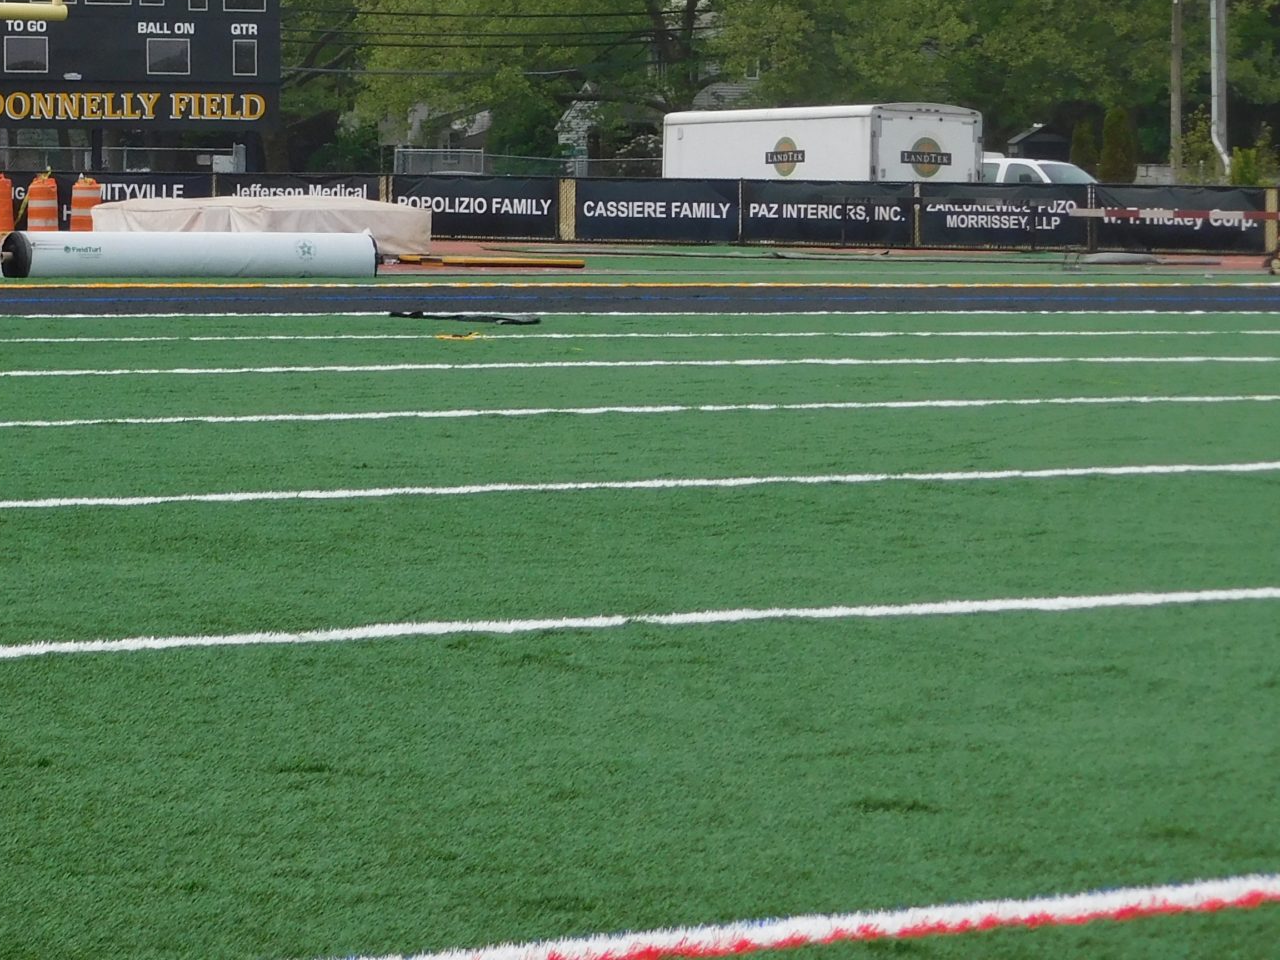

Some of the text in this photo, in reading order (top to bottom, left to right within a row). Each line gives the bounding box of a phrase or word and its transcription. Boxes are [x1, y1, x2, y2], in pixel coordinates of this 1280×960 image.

[6, 19, 47, 32] TO GO
[137, 22, 195, 35] BALL ON
[230, 24, 258, 35] QTR
[169, 93, 266, 121] FIELD
[232, 184, 368, 199] Jefferson Medical
[492, 198, 552, 215] FAMILY
[583, 200, 731, 219] CASSIERE FAMILY
[749, 203, 778, 218] PAZ
[875, 206, 906, 221] INC.
[946, 215, 1061, 231] MORRISSEY, LLP
